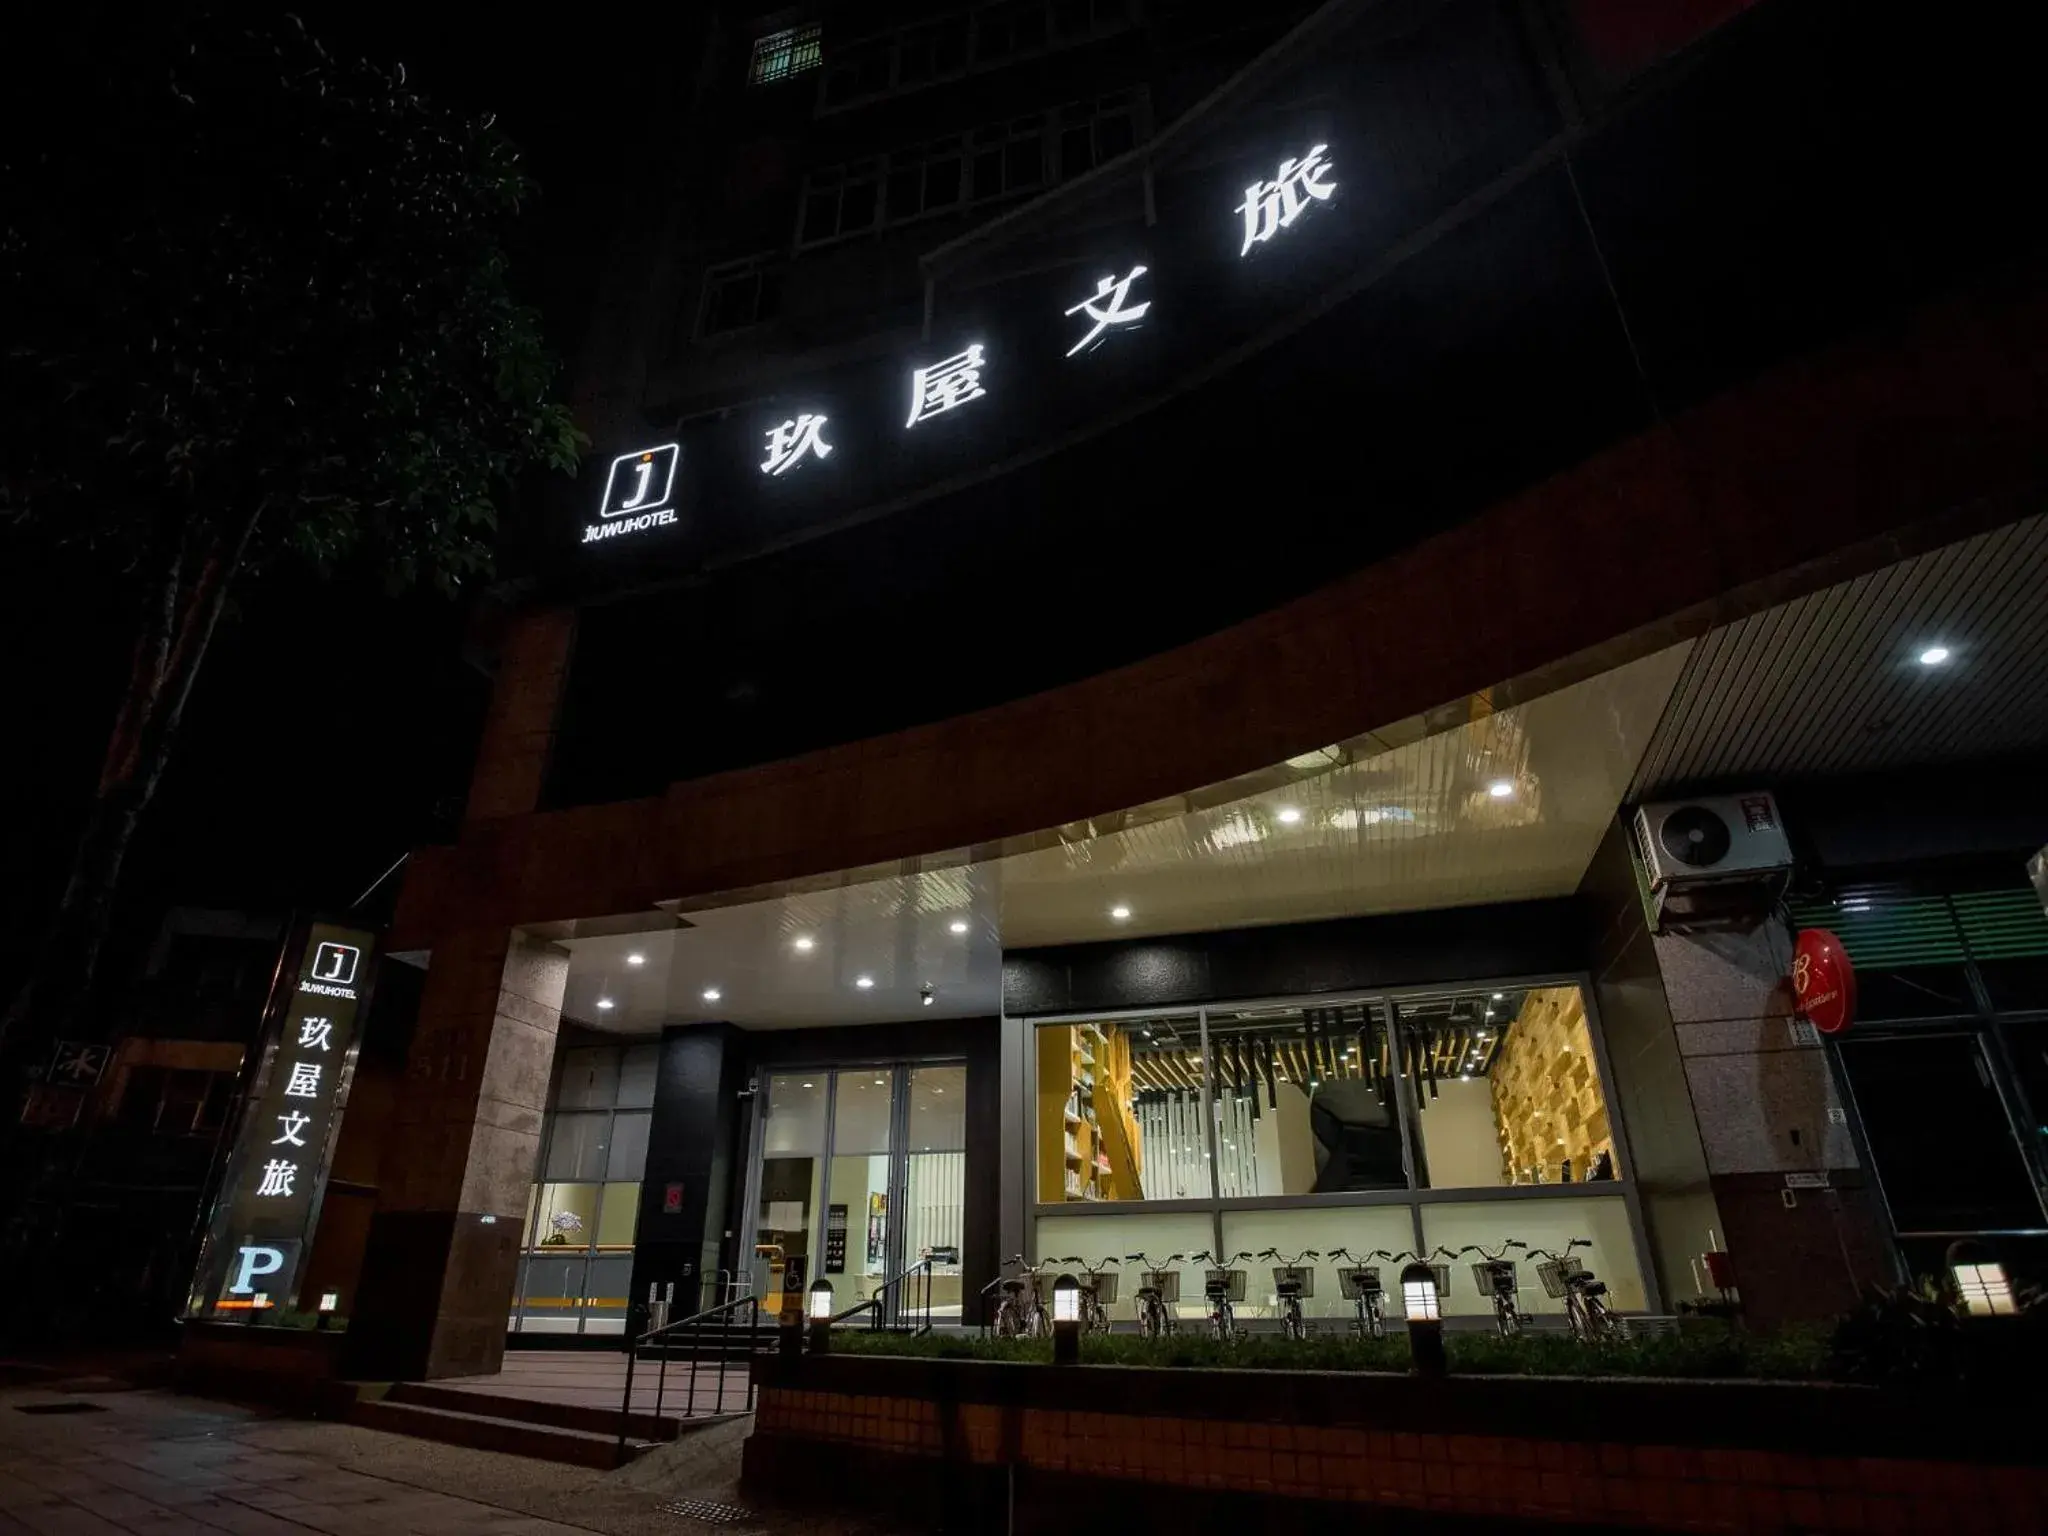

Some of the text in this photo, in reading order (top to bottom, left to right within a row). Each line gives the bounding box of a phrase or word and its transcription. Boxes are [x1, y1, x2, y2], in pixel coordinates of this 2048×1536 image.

[760, 143, 1338, 477] 玖屋文旅
[256, 1015, 333, 1198] 玖屋文旅
[229, 1245, 285, 1294] P
